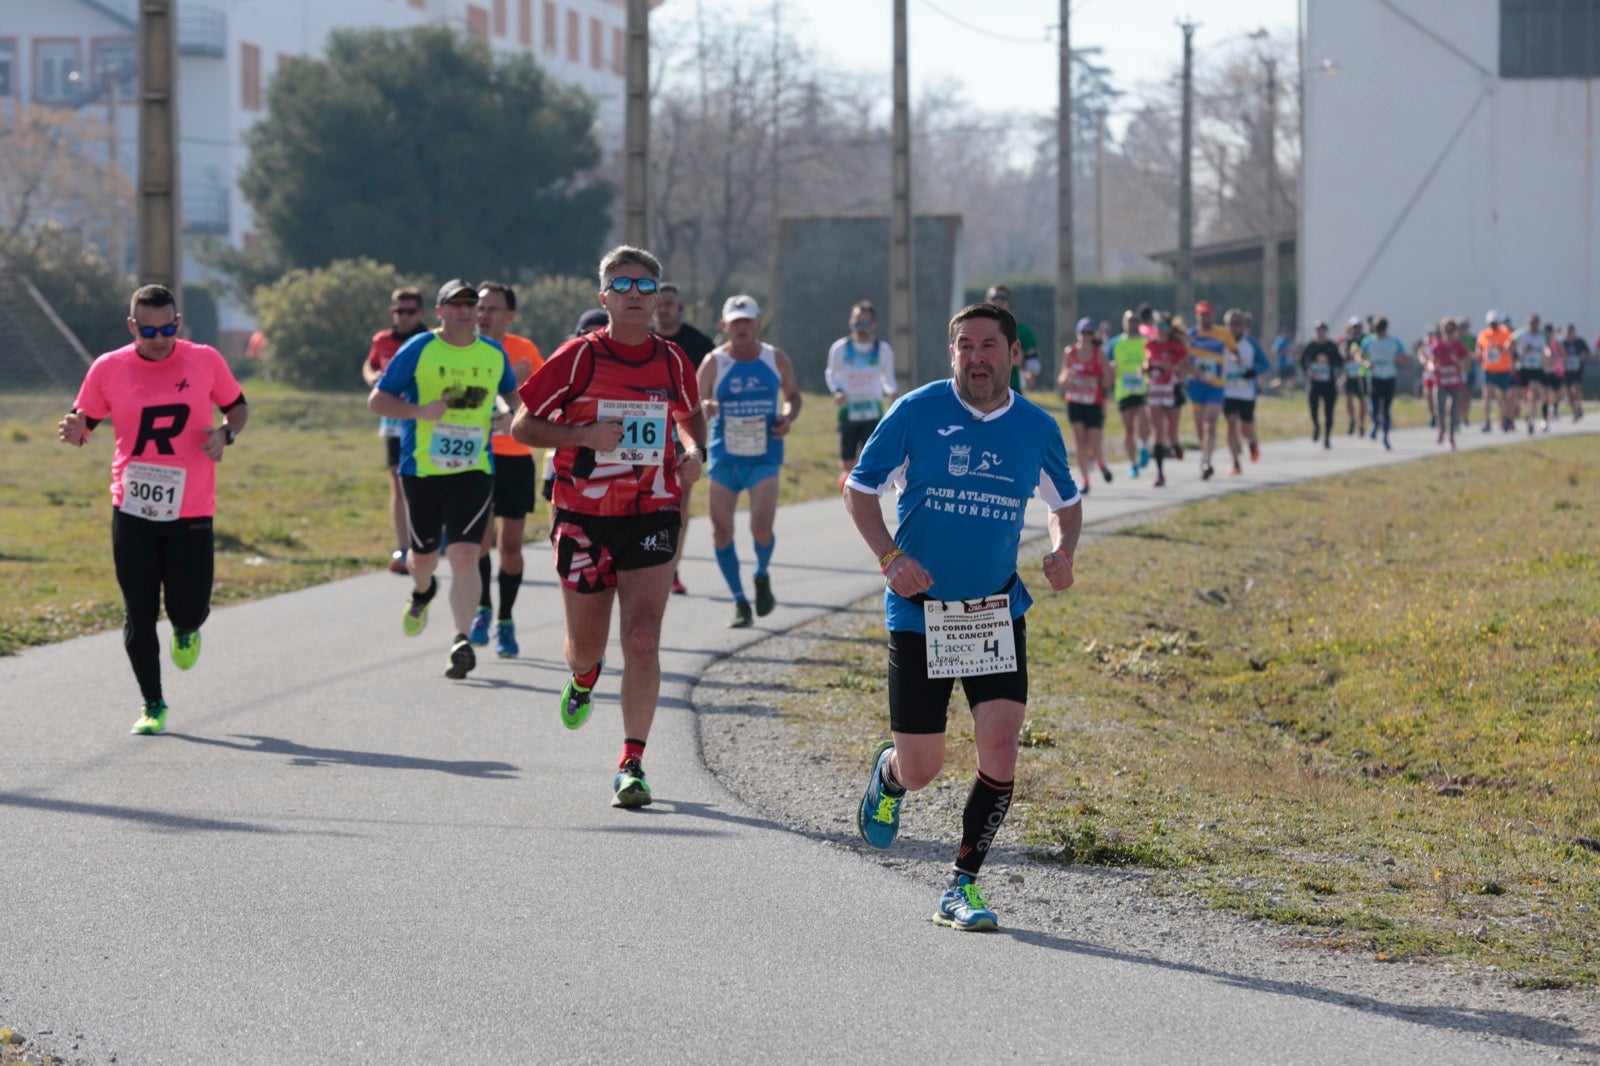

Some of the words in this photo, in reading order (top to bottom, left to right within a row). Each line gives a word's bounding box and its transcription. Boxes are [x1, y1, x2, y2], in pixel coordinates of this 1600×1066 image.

[131, 403, 191, 456] R
[619, 421, 656, 445] 16
[439, 437, 475, 456] 329
[130, 480, 175, 504] 3061
[925, 486, 955, 498] CLUB
[957, 490, 1021, 508] ATLETISMO
[942, 624, 973, 632] CORRO
[975, 620, 1010, 630] CONTRA
[959, 631, 994, 639] CANCER
[944, 643, 976, 653] aecc
[984, 639, 999, 658] 4
[976, 793, 1011, 852] WONG
